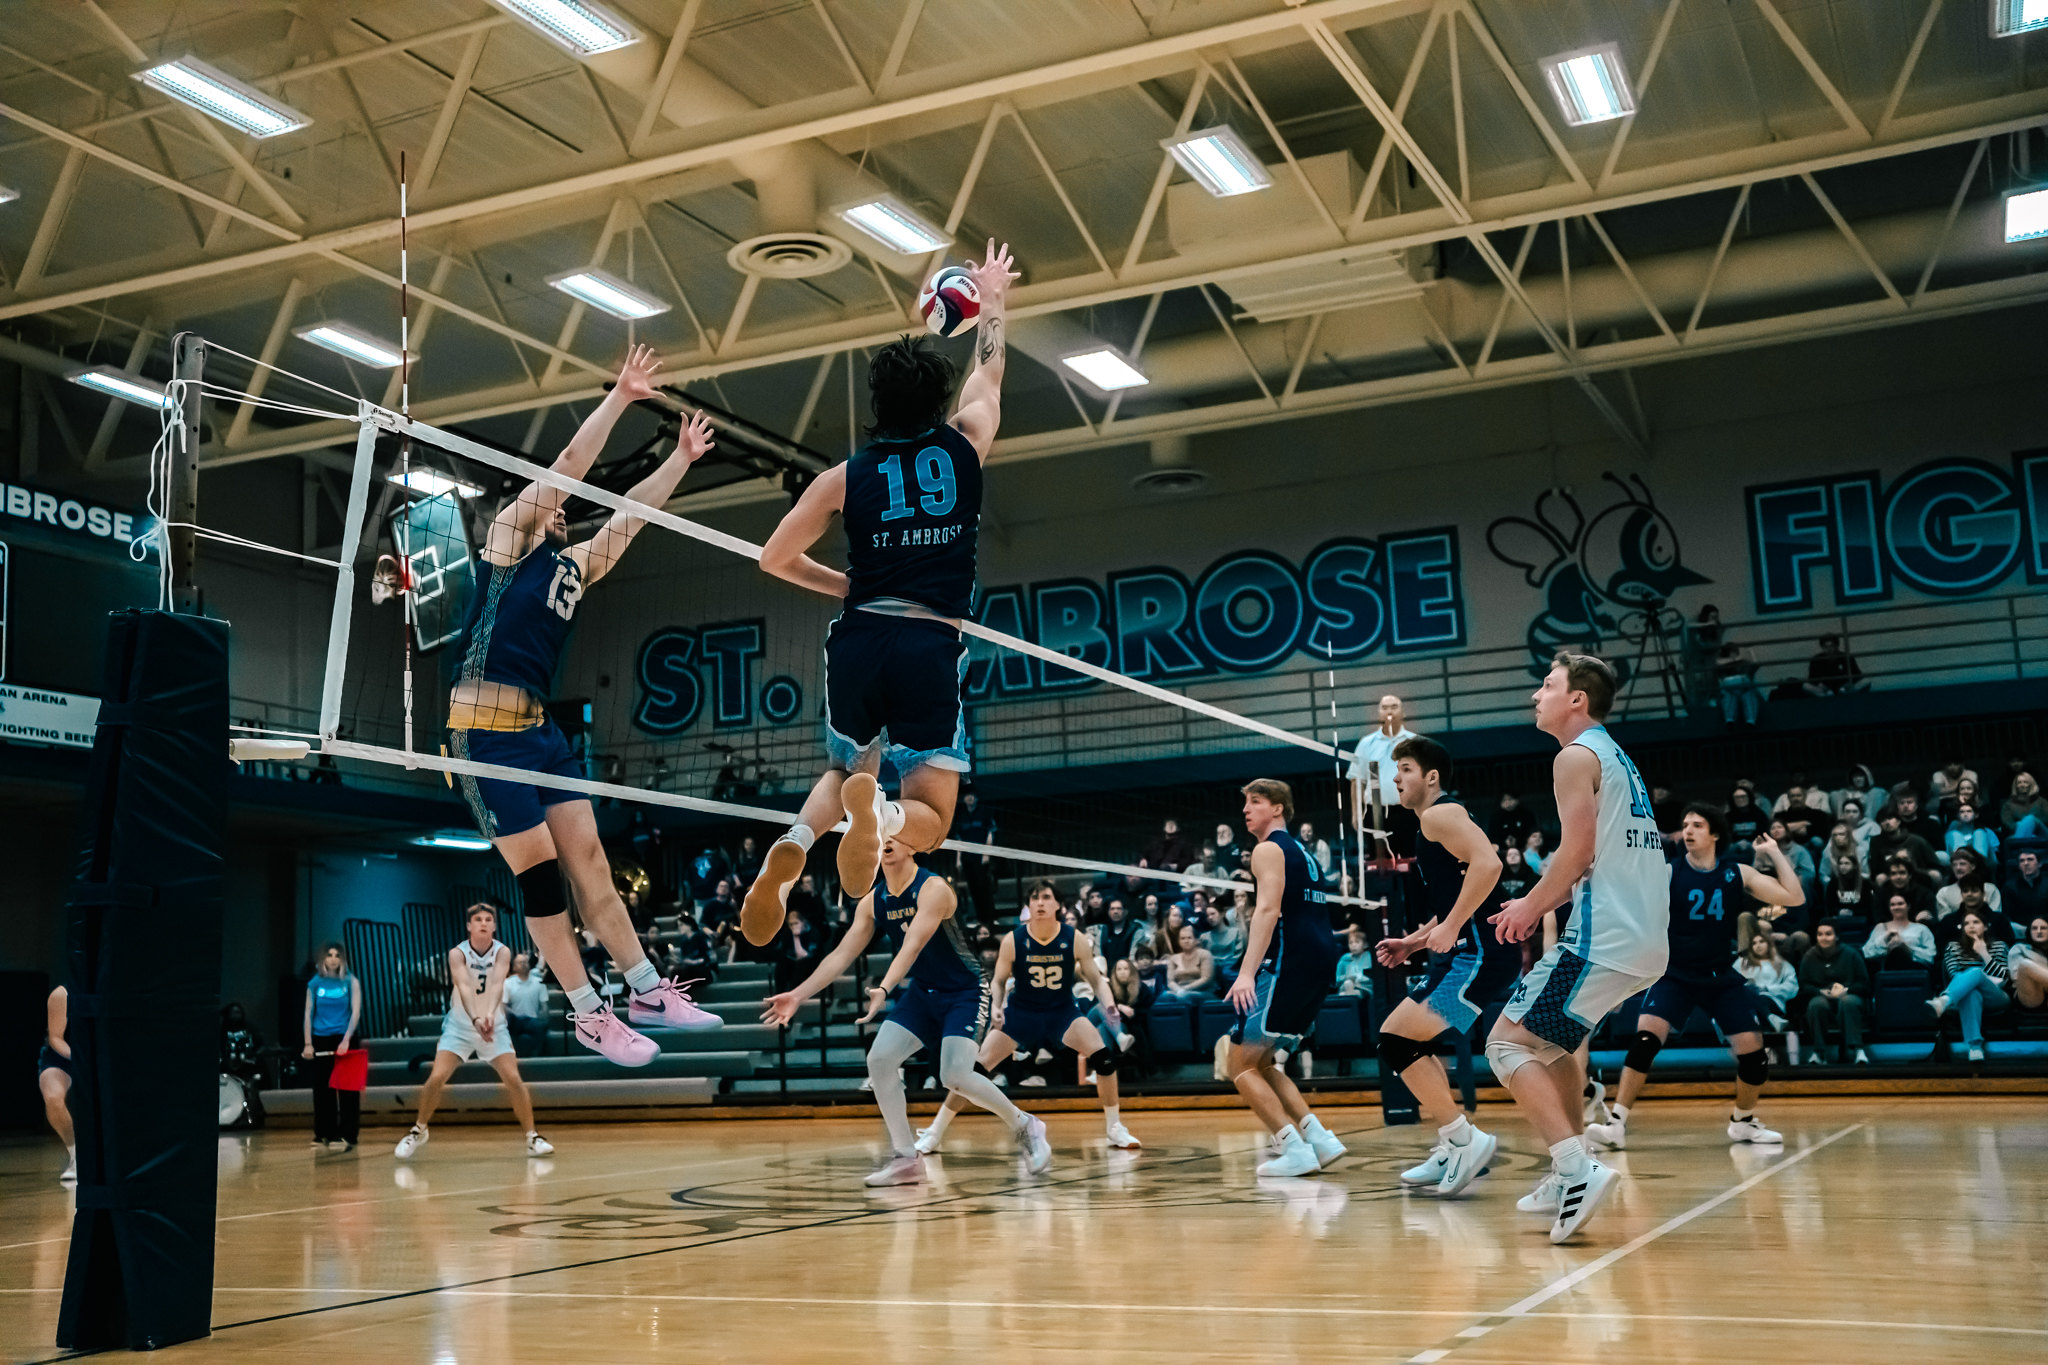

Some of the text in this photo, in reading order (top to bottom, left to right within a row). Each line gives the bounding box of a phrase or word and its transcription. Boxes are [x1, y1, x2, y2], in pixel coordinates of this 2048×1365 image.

[877, 445, 957, 521] 19
[0, 482, 133, 543] BROSE
[872, 531, 893, 548] ST.
[636, 618, 801, 735] ST.
[23, 691, 68, 706] ARENA
[1626, 829, 1642, 848] ST.
[1687, 888, 1725, 921] 24
[475, 974, 487, 995] 3
[1028, 965, 1063, 991] 32
